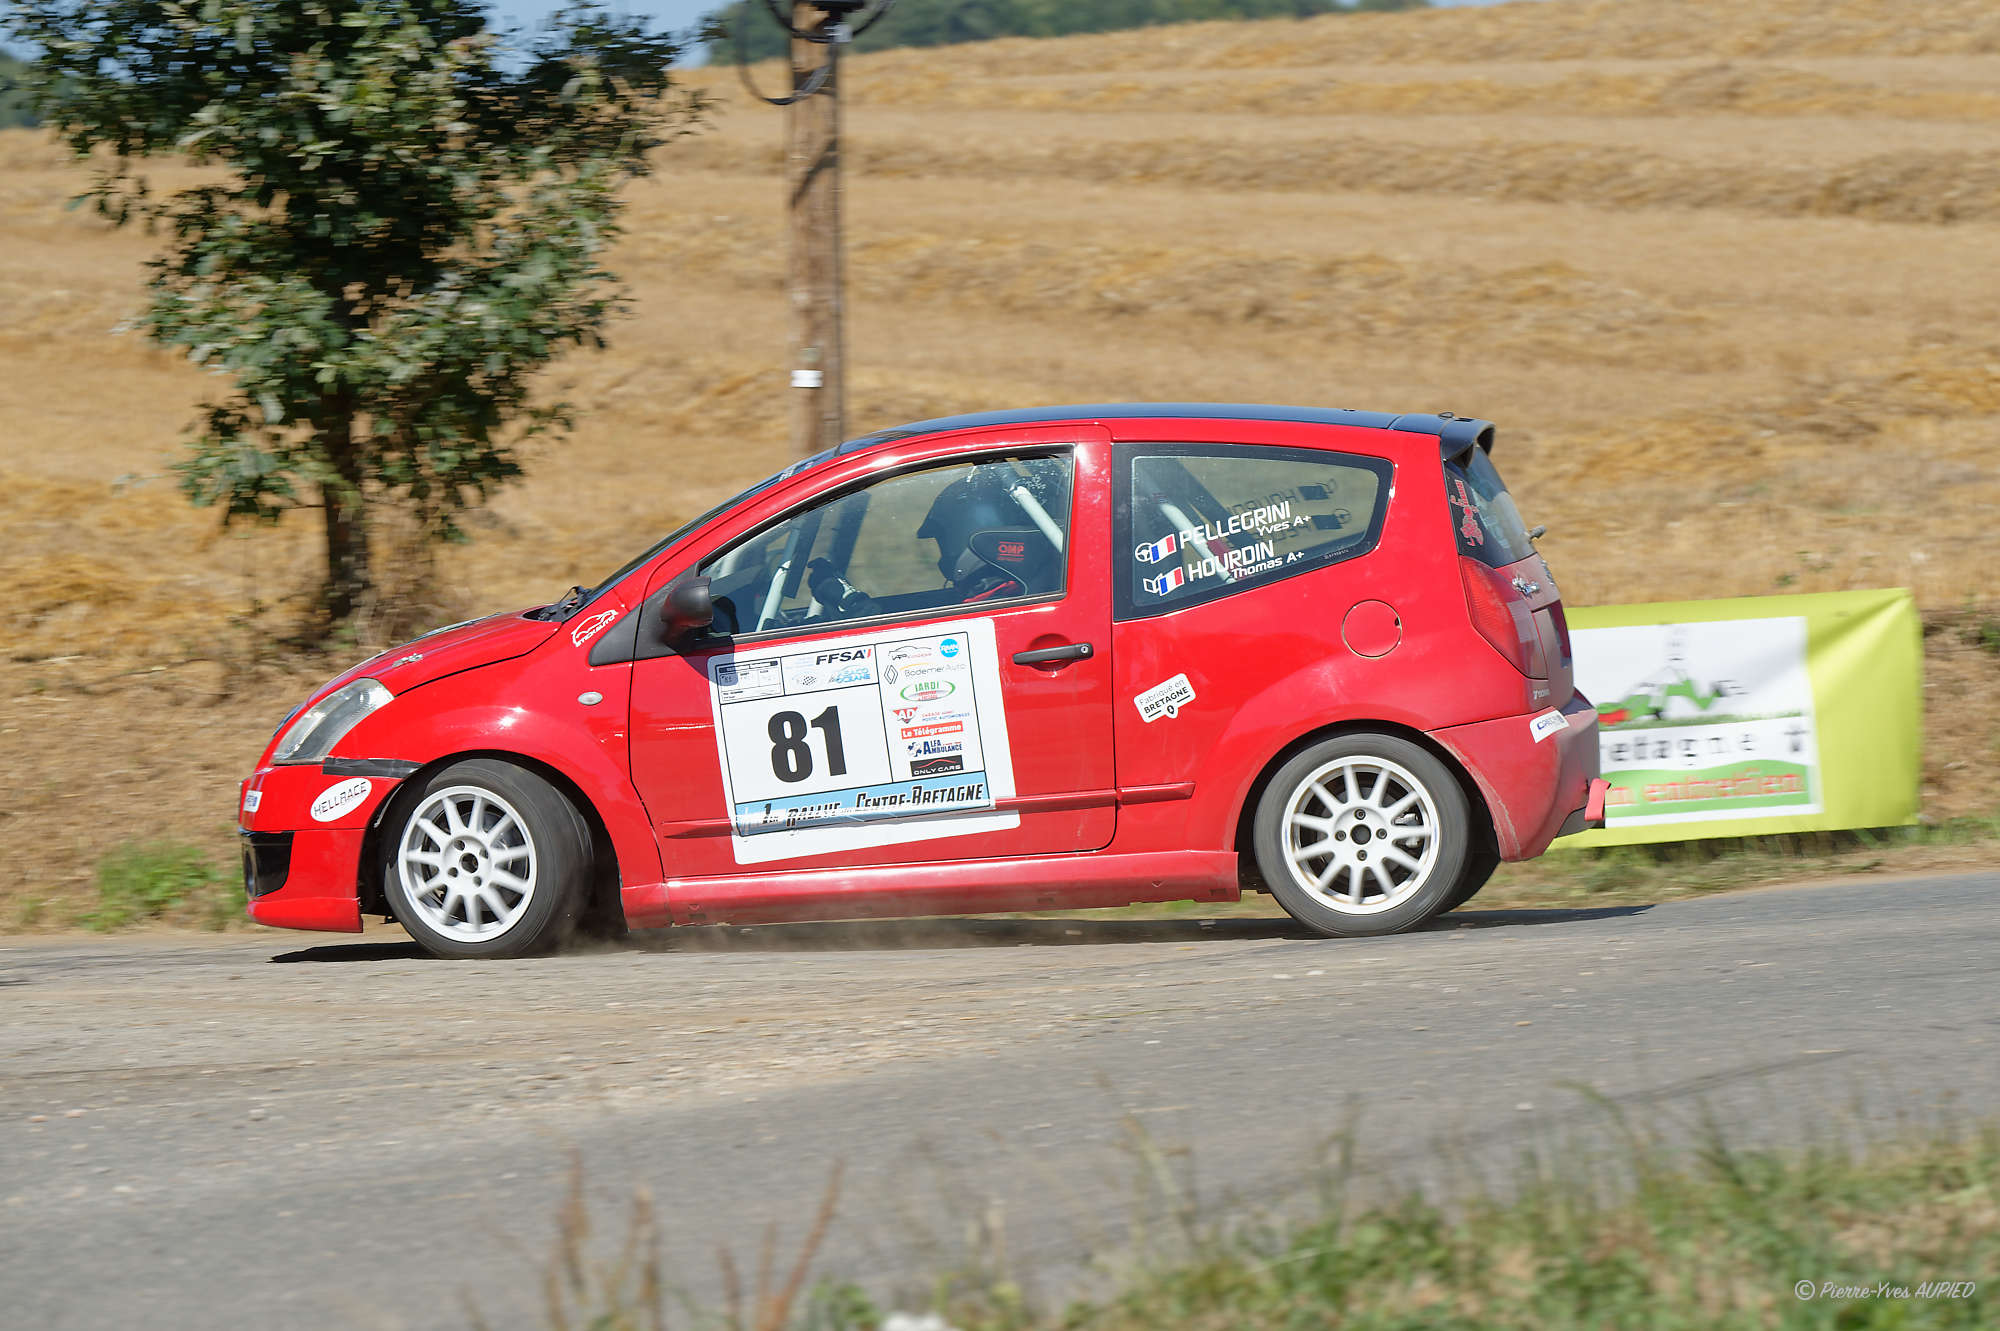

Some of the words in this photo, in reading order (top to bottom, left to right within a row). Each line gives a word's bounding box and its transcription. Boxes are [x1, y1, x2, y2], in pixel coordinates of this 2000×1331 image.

[1179, 500, 1291, 549] PELLEGRINI
[1256, 521, 1290, 536] Yves
[1293, 514, 1312, 527] A+
[998, 544, 1024, 554] OMP
[1188, 539, 1275, 582] HOURDIN
[1230, 557, 1283, 580] Thomas
[1286, 551, 1305, 564] A+
[816, 649, 866, 665] FFSA
[1175, 679, 1185, 688] en
[1144, 686, 1189, 714] BRETAGNE
[898, 709, 914, 720] AD
[767, 705, 847, 783] 81
[313, 781, 367, 817] HELLRACE
